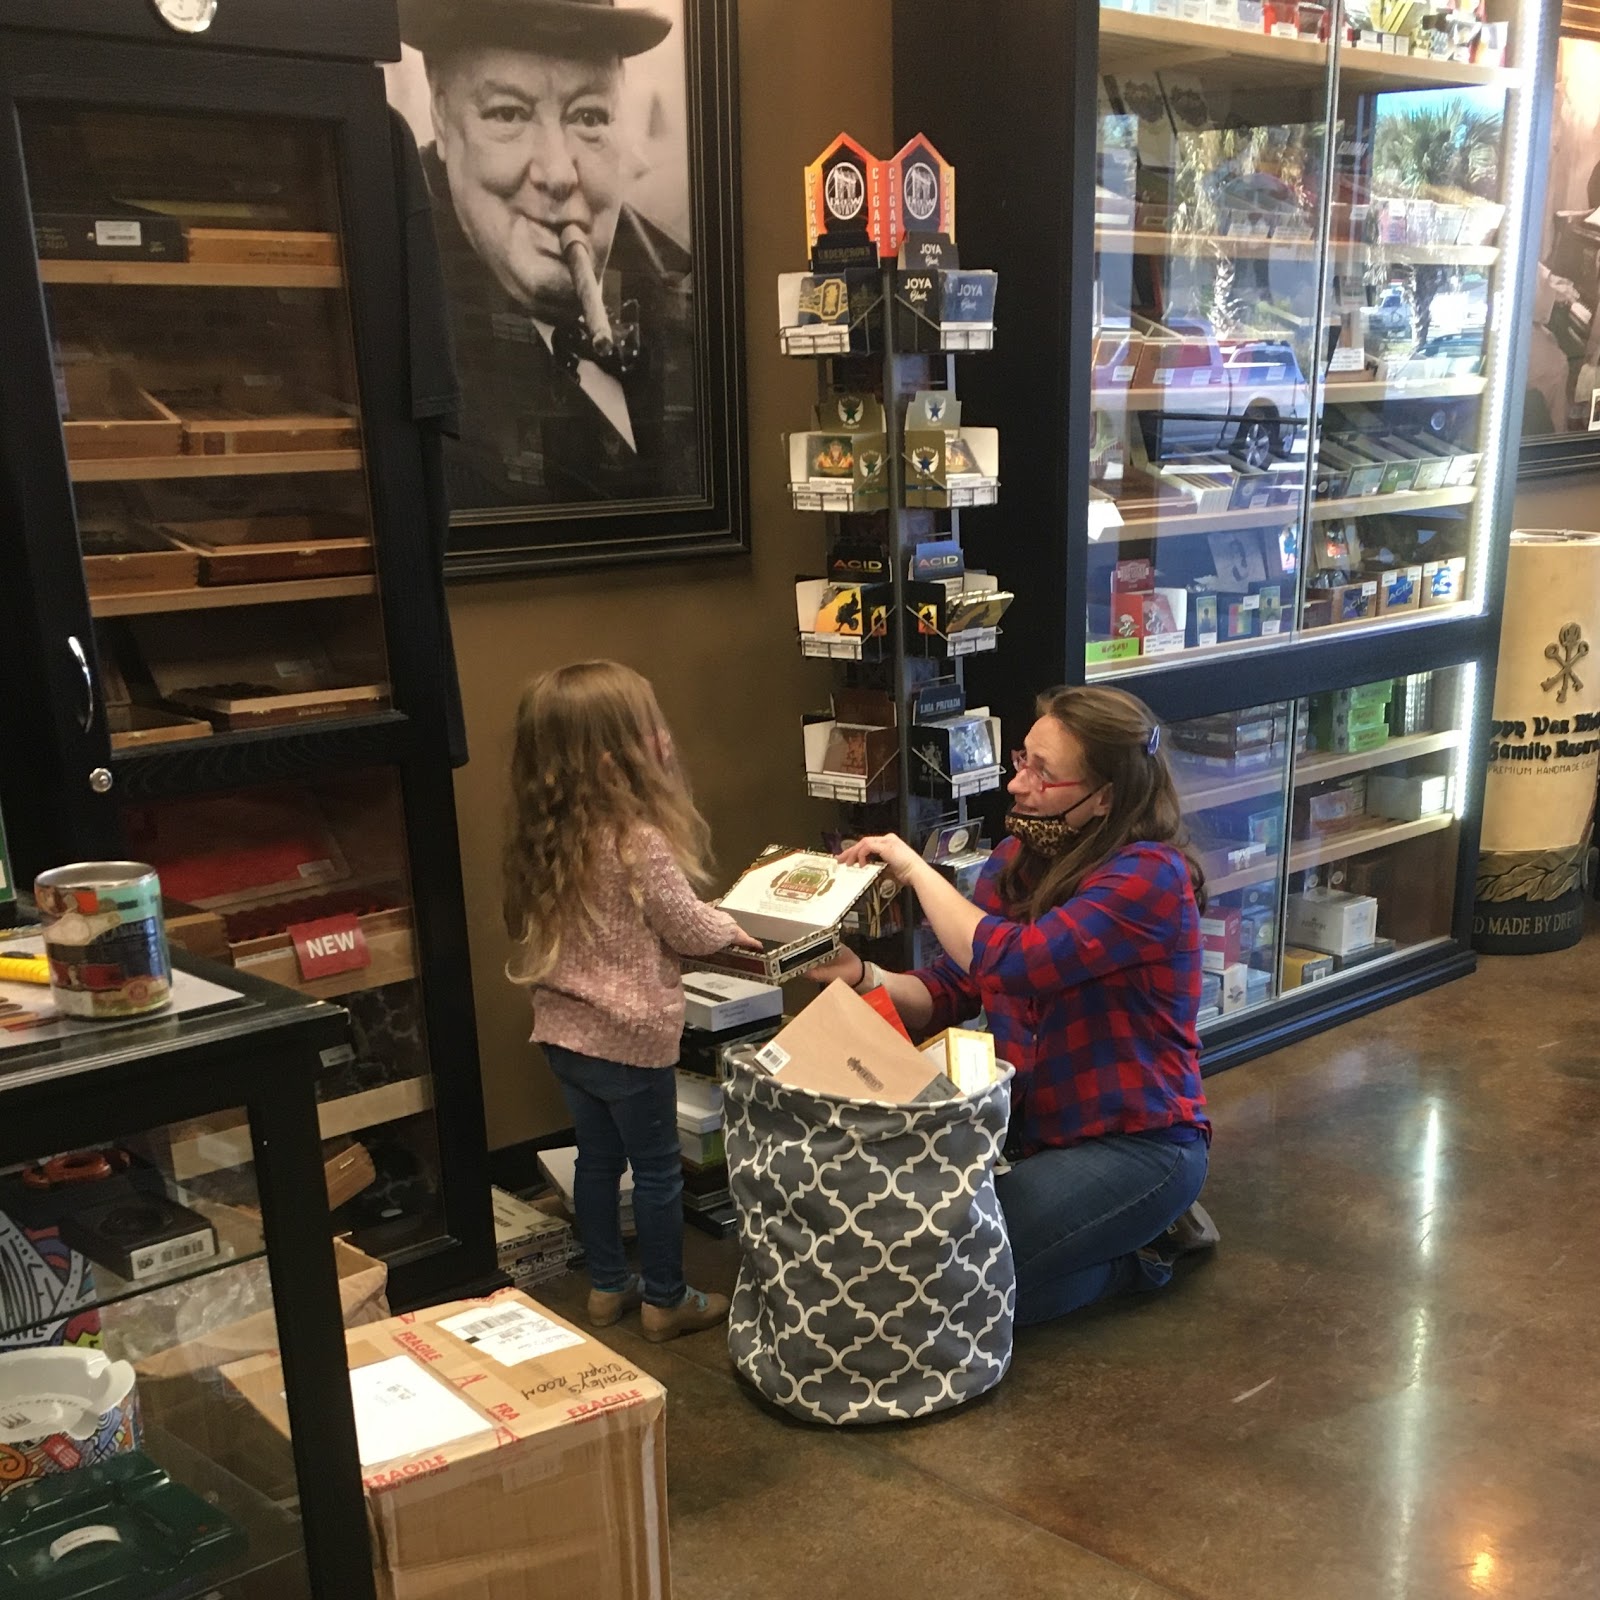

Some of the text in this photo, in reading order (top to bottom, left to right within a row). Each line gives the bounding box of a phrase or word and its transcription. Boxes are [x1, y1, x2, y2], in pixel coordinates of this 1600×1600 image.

[888, 167, 898, 250] CIGARS
[920, 243, 943, 255] JOYA
[904, 277, 933, 290] JOYA
[957, 284, 983, 297] JOYA
[833, 559, 883, 570] ACID
[918, 555, 959, 568] ACID
[1536, 763, 1580, 775] HANDMADE
[1487, 917, 1531, 935] MADE
[1533, 915, 1552, 934] BY
[305, 930, 355, 959] NEW
[397, 1331, 444, 1362] FRAGILE
[363, 1454, 448, 1489] FRAGILE
